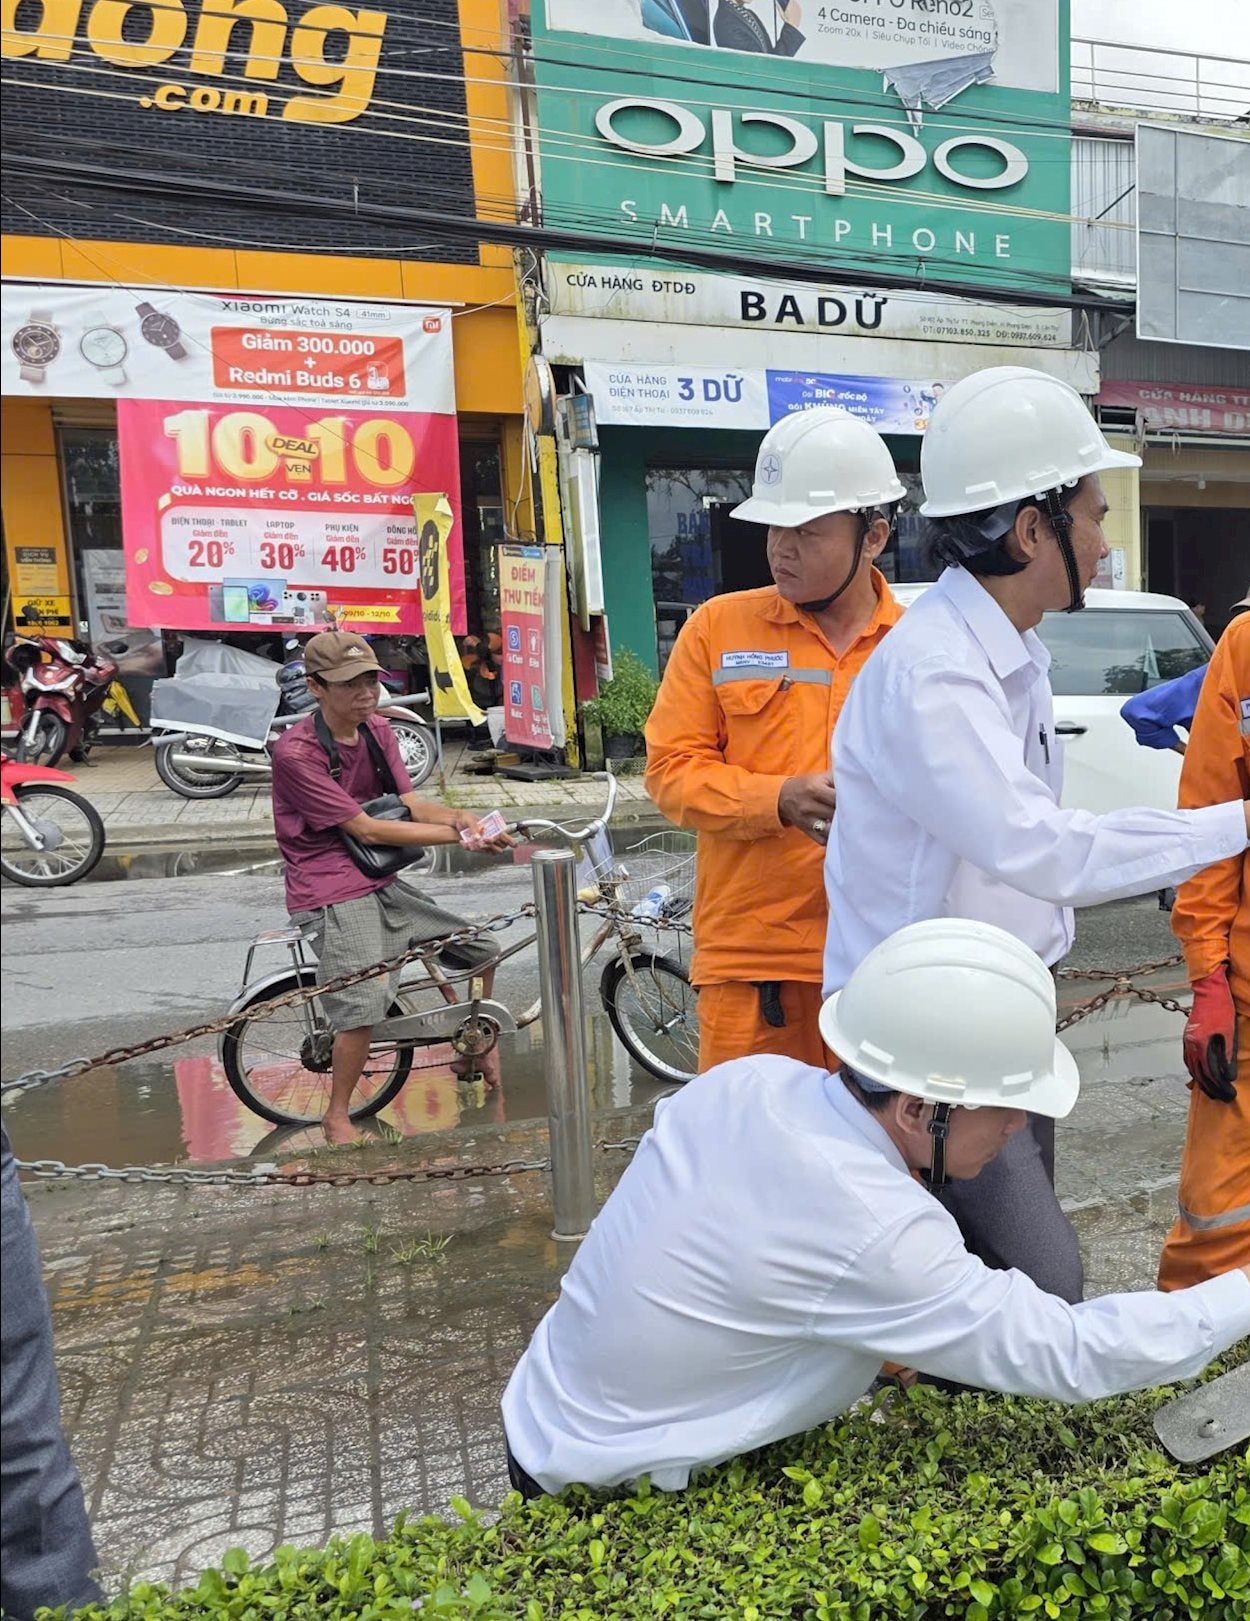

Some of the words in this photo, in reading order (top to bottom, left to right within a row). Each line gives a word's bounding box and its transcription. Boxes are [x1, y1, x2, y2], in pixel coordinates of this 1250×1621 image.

[817, 7, 827, 20] 4
[830, 8, 885, 28] Camera
[897, 17, 916, 32] Đa
[959, 26, 991, 44] sáng
[818, 23, 843, 36] Zoom
[845, 27, 862, 38] 20x
[139, 83, 269, 117] .com
[619, 199, 1012, 258] SMARTPHONE
[566, 271, 598, 289] CỬA
[601, 273, 644, 292] HÀNG
[652, 280, 696, 295] ĐTDĐ
[291, 305, 330, 317] Watch
[336, 307, 351, 318] S4
[740, 290, 805, 325] BA
[817, 291, 888, 330] DỮ
[241, 332, 292, 352] Giảm
[297, 336, 375, 356] 300.000
[229, 367, 291, 386] Redmi
[296, 369, 344, 388] Buds
[348, 373, 361, 389] 6
[636, 373, 667, 386] HÀNG
[677, 377, 695, 401] 3
[703, 373, 744, 403] DỮ
[272, 437, 317, 456] DEAL
[285, 463, 312, 476] VẸN
[171, 484, 202, 497] QUÀ
[206, 486, 247, 499] NGON
[249, 486, 276, 499] HẾT
[307, 489, 332, 503] GIÁ
[266, 520, 295, 529] LAPTOP
[188, 540, 235, 568] 20%
[260, 541, 306, 570] 30%
[321, 545, 367, 573] 40%
[503, 588, 522, 605] THU
